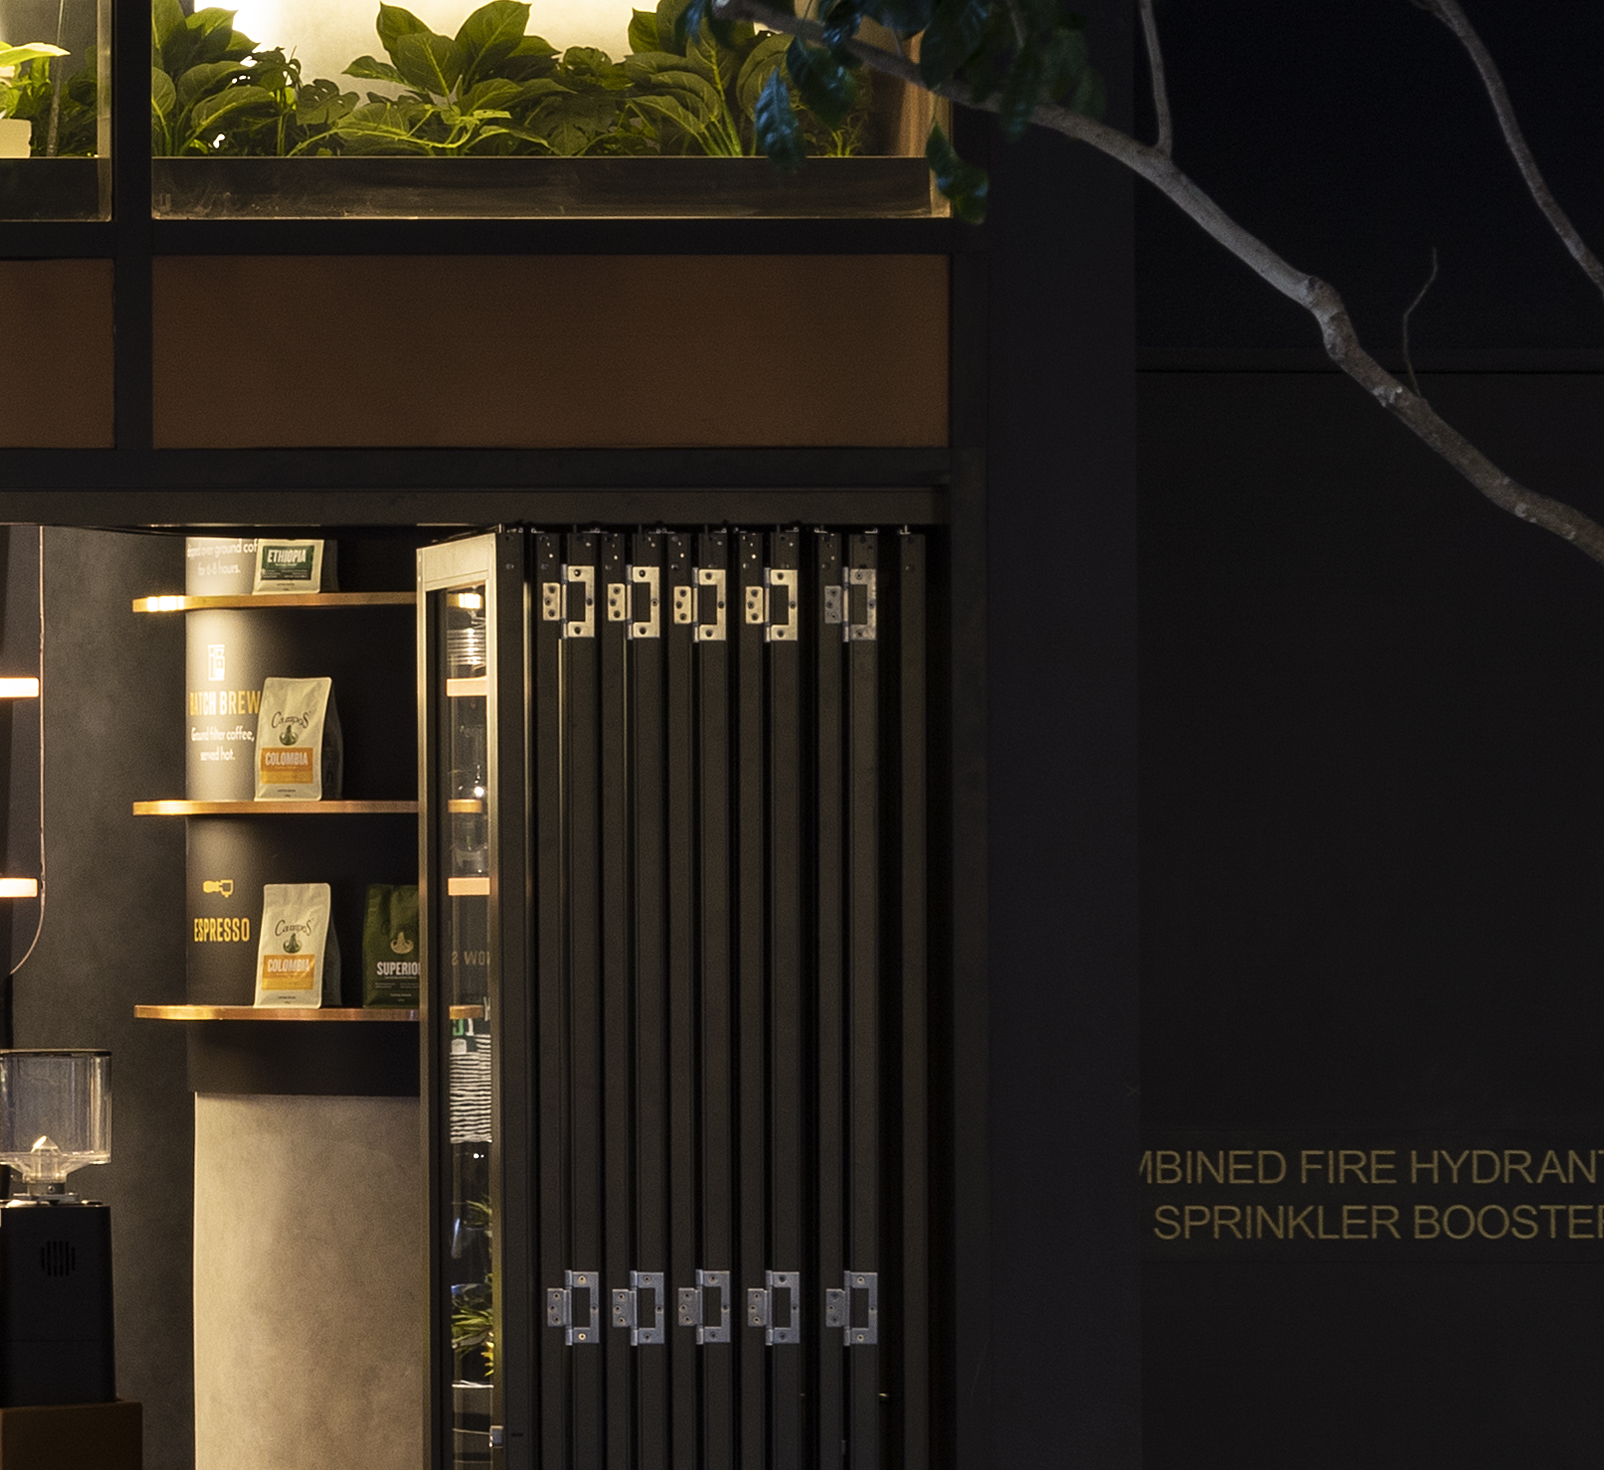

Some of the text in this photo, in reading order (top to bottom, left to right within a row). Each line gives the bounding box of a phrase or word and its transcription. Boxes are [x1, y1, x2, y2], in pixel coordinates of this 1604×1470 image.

[267, 549, 307, 564] ETHIOPIA
[219, 690, 261, 715] BREW
[226, 725, 255, 742] coffee,
[265, 751, 308, 766] COLOMBIA
[194, 918, 250, 942] ESPRESSO
[267, 959, 310, 972] COLOMBIA
[376, 961, 420, 976] SUPERIO
[1301, 1150, 1397, 1184] FIRE
[1153, 1205, 1401, 1240] SPRINKLER
